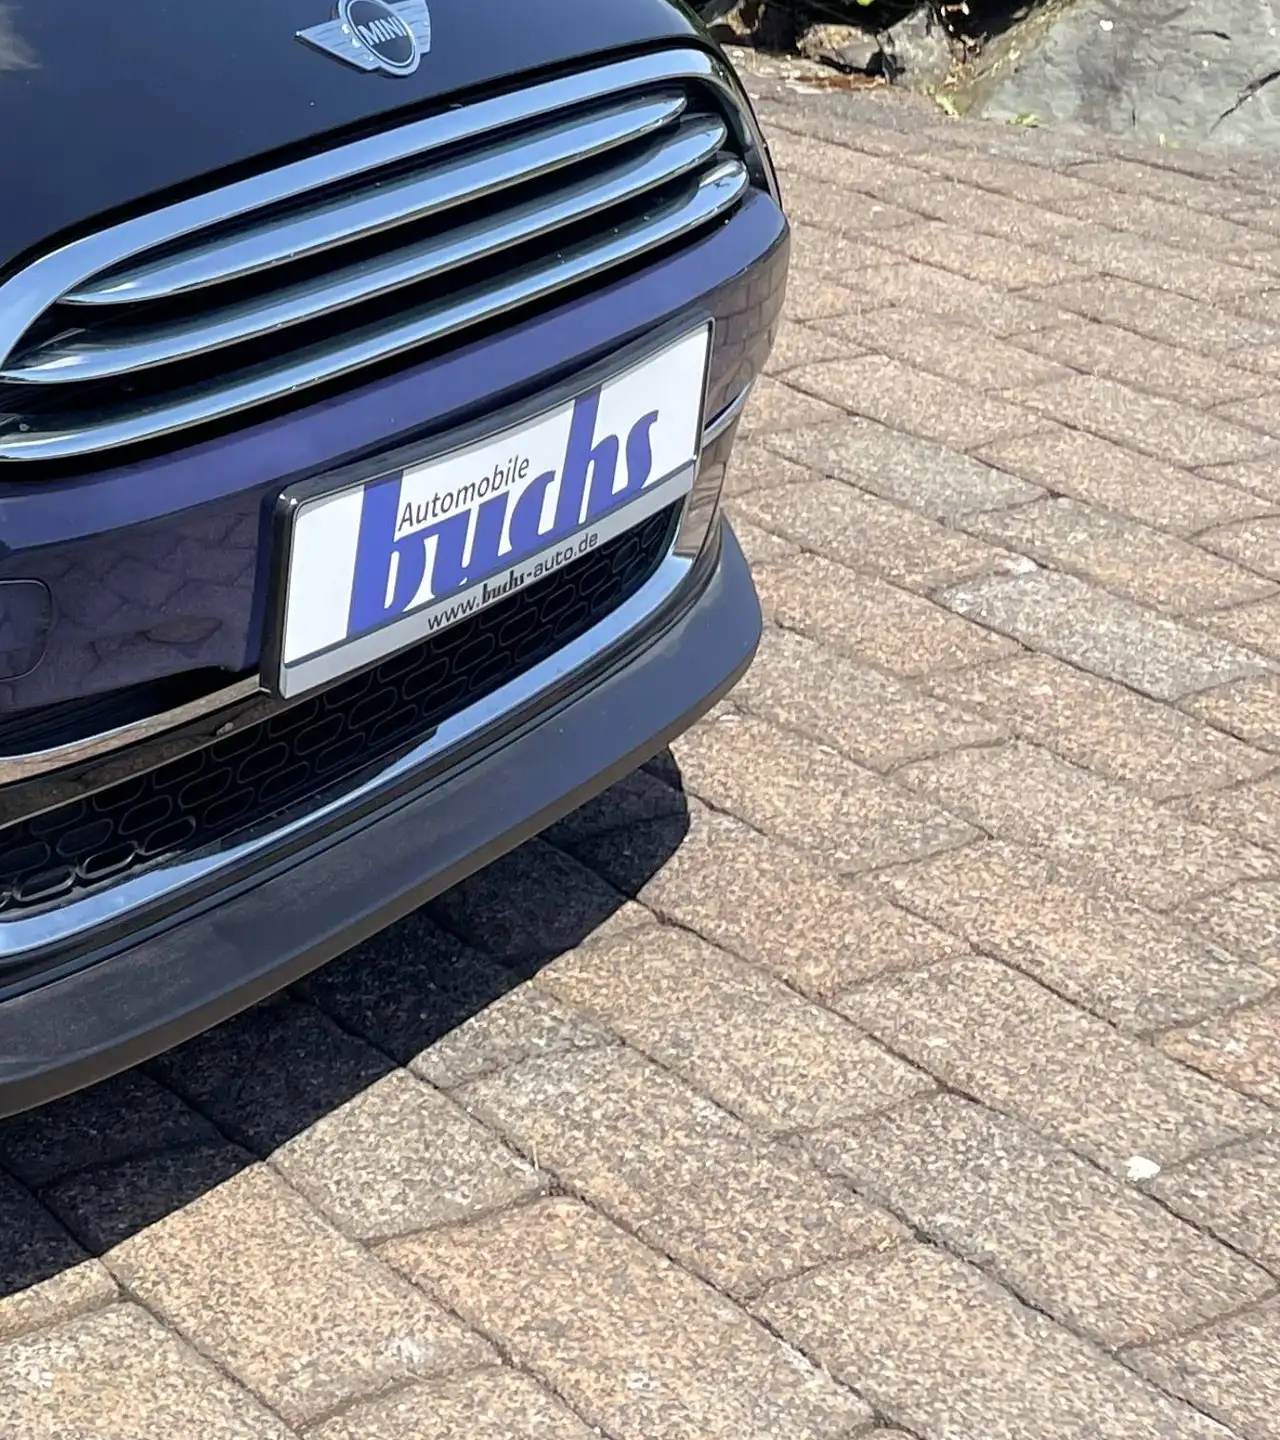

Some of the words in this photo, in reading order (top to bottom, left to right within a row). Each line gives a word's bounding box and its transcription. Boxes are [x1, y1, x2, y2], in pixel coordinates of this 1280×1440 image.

[357, 16, 408, 46] MINI
[346, 384, 660, 639] buchs
[398, 454, 530, 532] Automobile
[427, 533, 598, 630] www.buchs-auto.de
